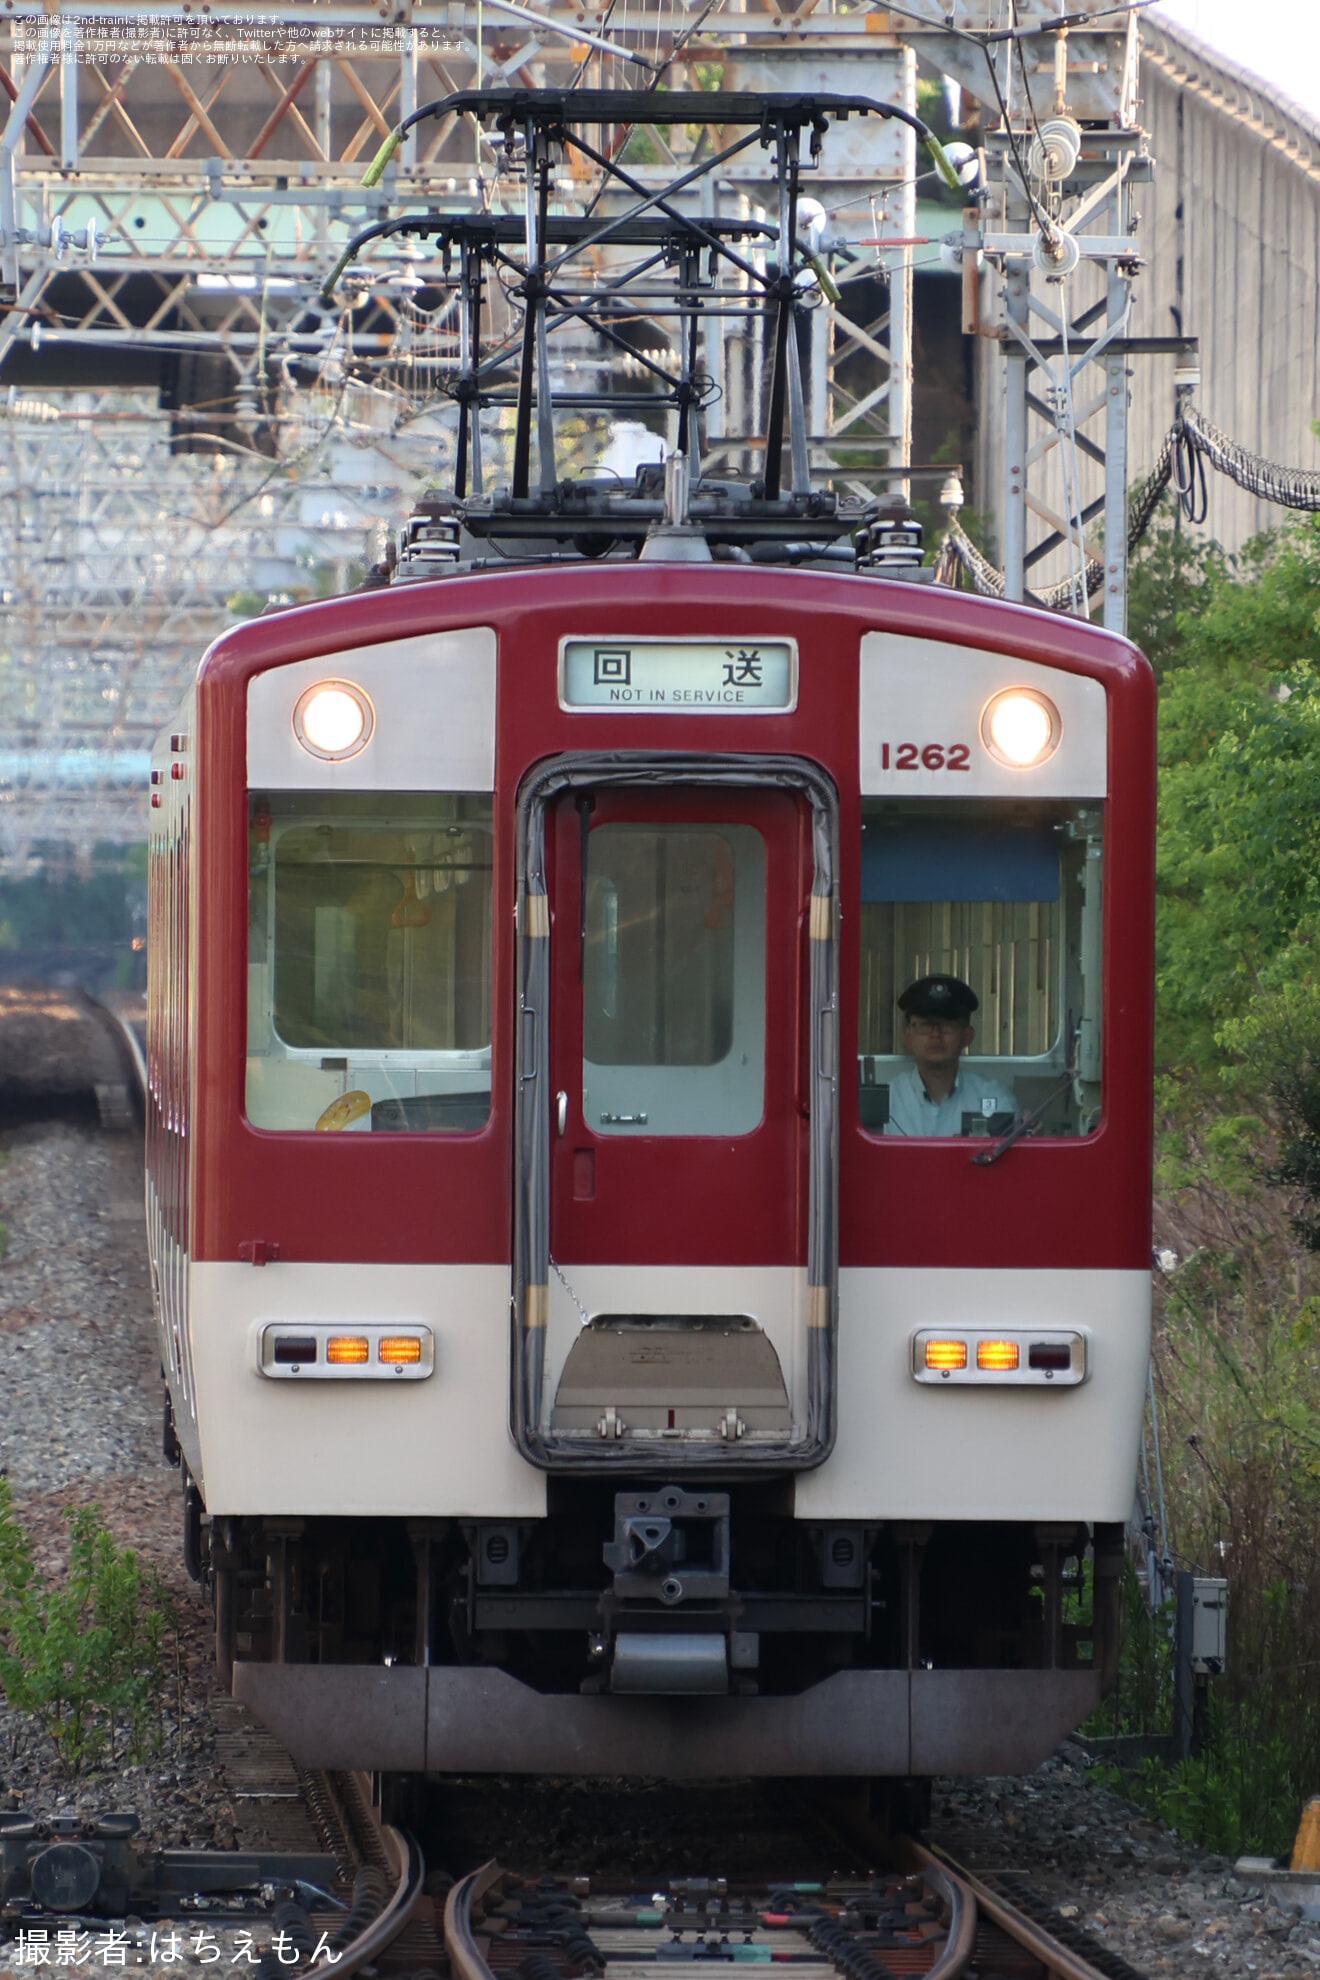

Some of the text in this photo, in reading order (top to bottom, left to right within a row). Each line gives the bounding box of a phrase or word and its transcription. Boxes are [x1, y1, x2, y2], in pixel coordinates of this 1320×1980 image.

[610, 689, 745, 703] NOT IN SERVICE
[881, 742, 971, 771] 1262
